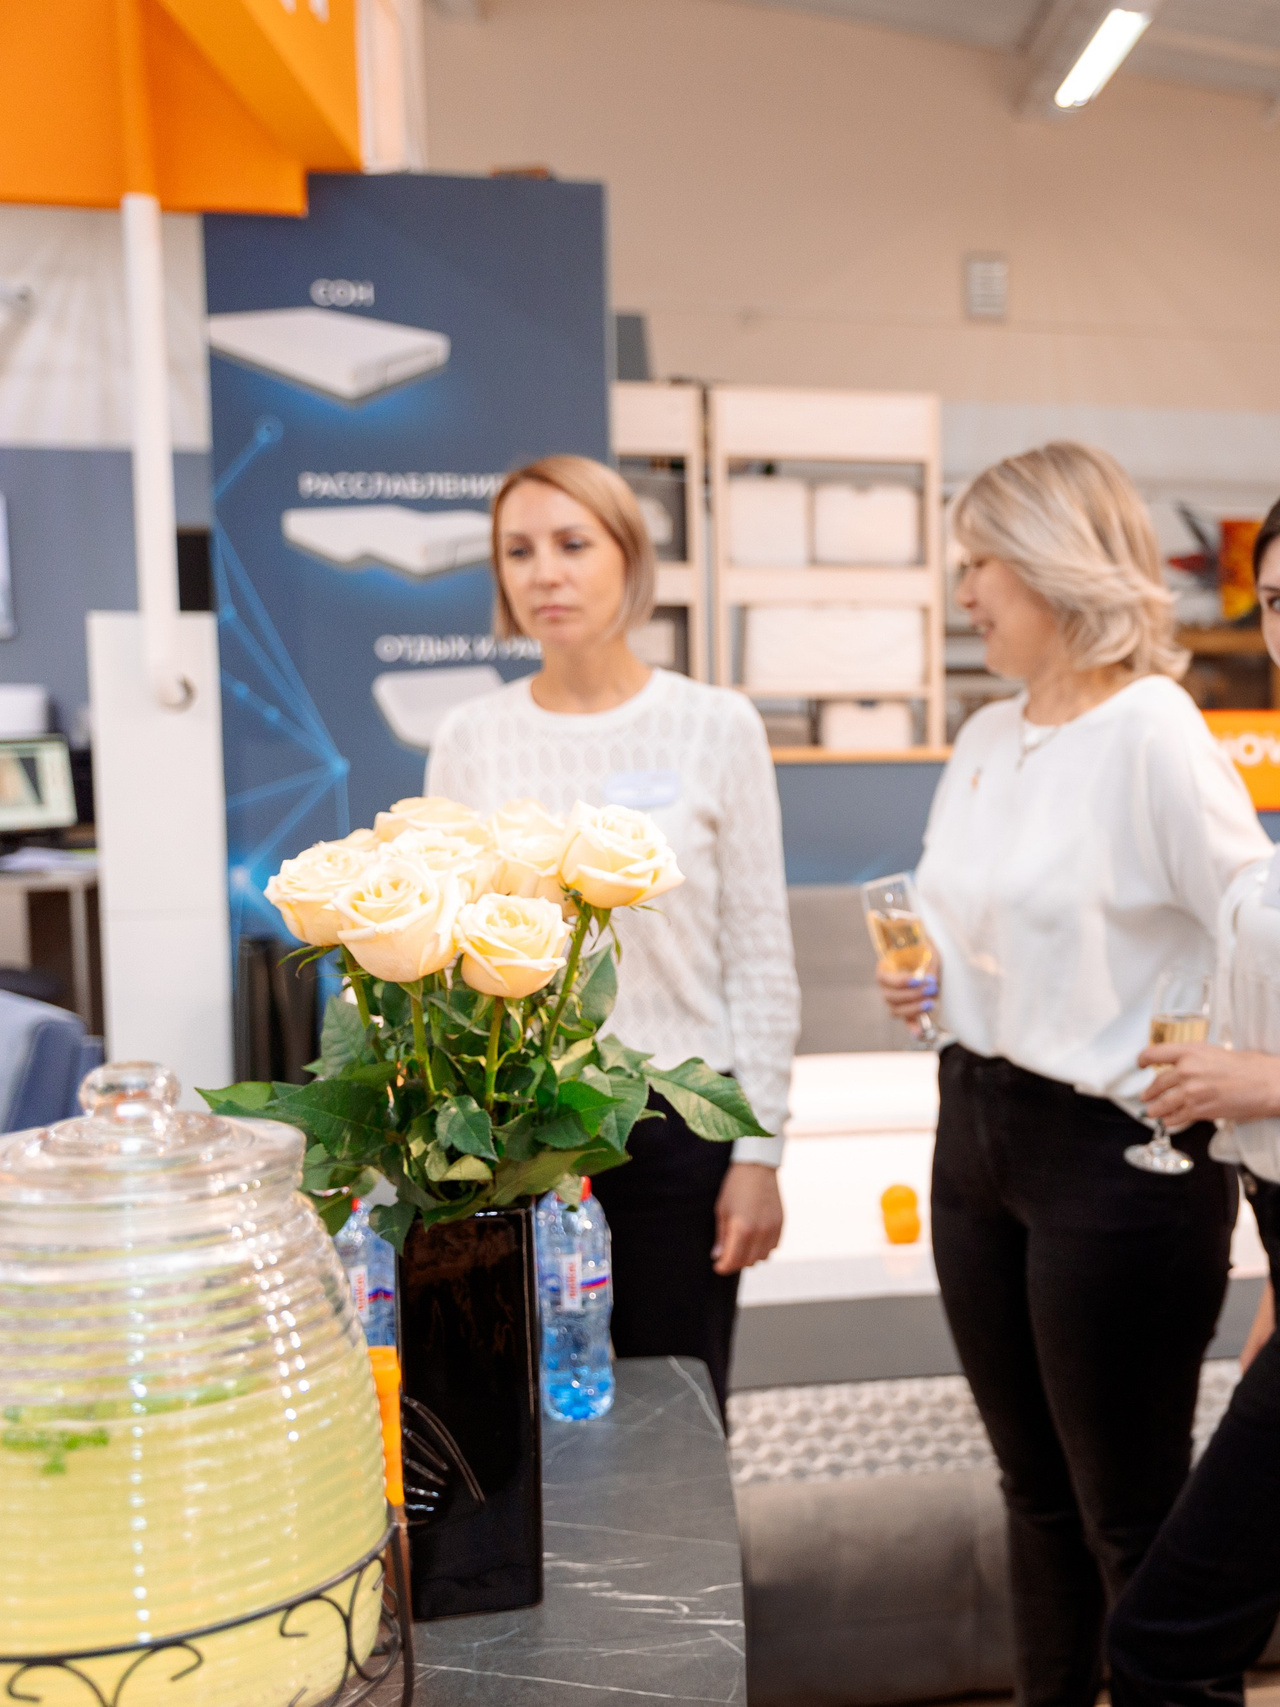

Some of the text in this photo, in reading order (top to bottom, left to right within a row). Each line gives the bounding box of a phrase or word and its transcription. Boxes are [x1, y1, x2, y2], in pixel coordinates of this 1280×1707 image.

[310, 278, 375, 307] СОН
[373, 634, 472, 664] ОТДЫХ
[473, 634, 497, 661] И
